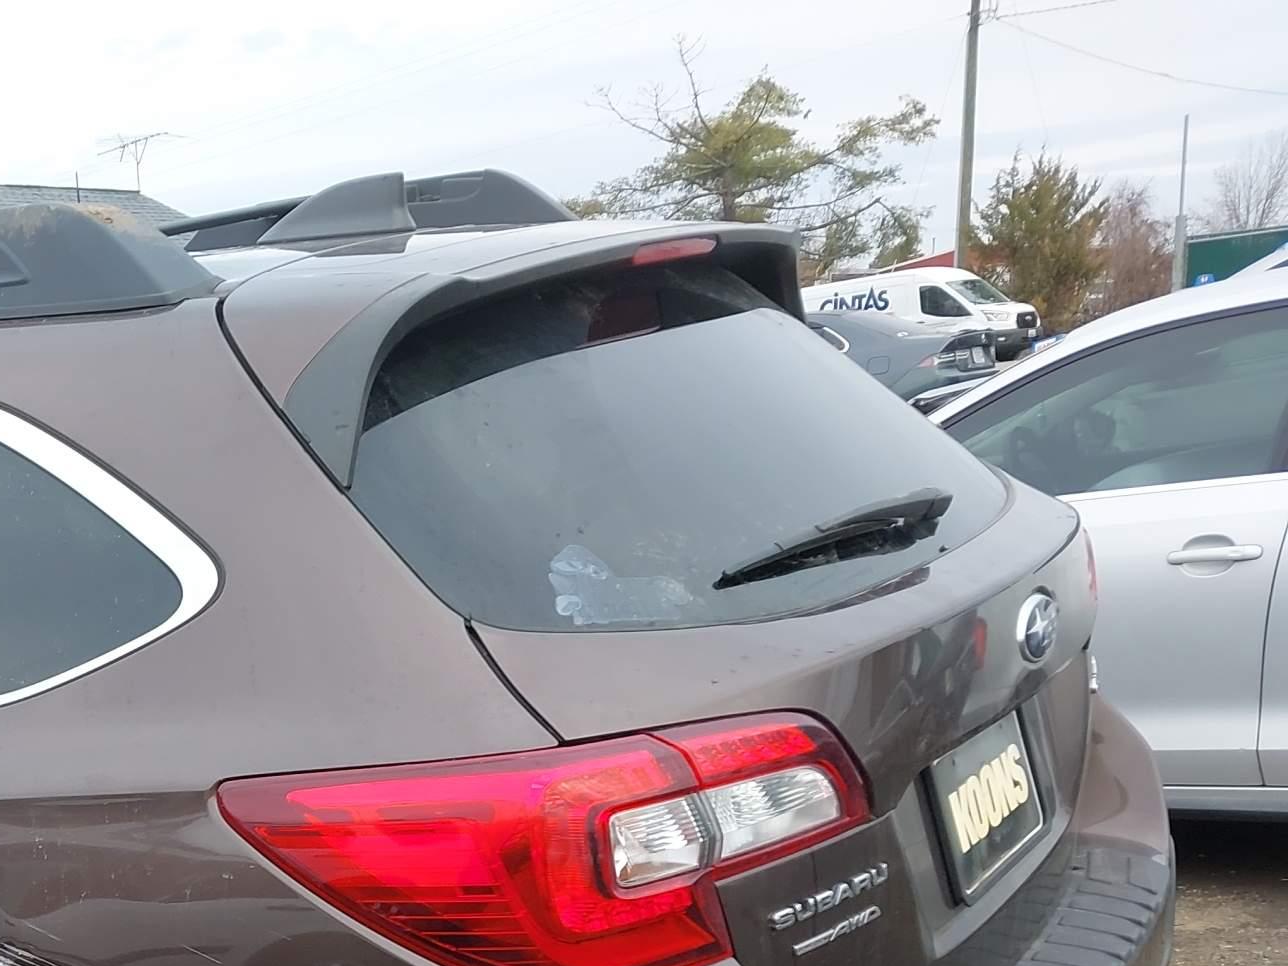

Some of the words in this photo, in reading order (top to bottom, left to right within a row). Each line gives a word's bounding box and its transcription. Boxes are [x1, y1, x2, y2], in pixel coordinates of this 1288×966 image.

[948, 743, 1029, 854] KOONS
[768, 862, 889, 931] SUBARU
[830, 905, 882, 942] AWD
